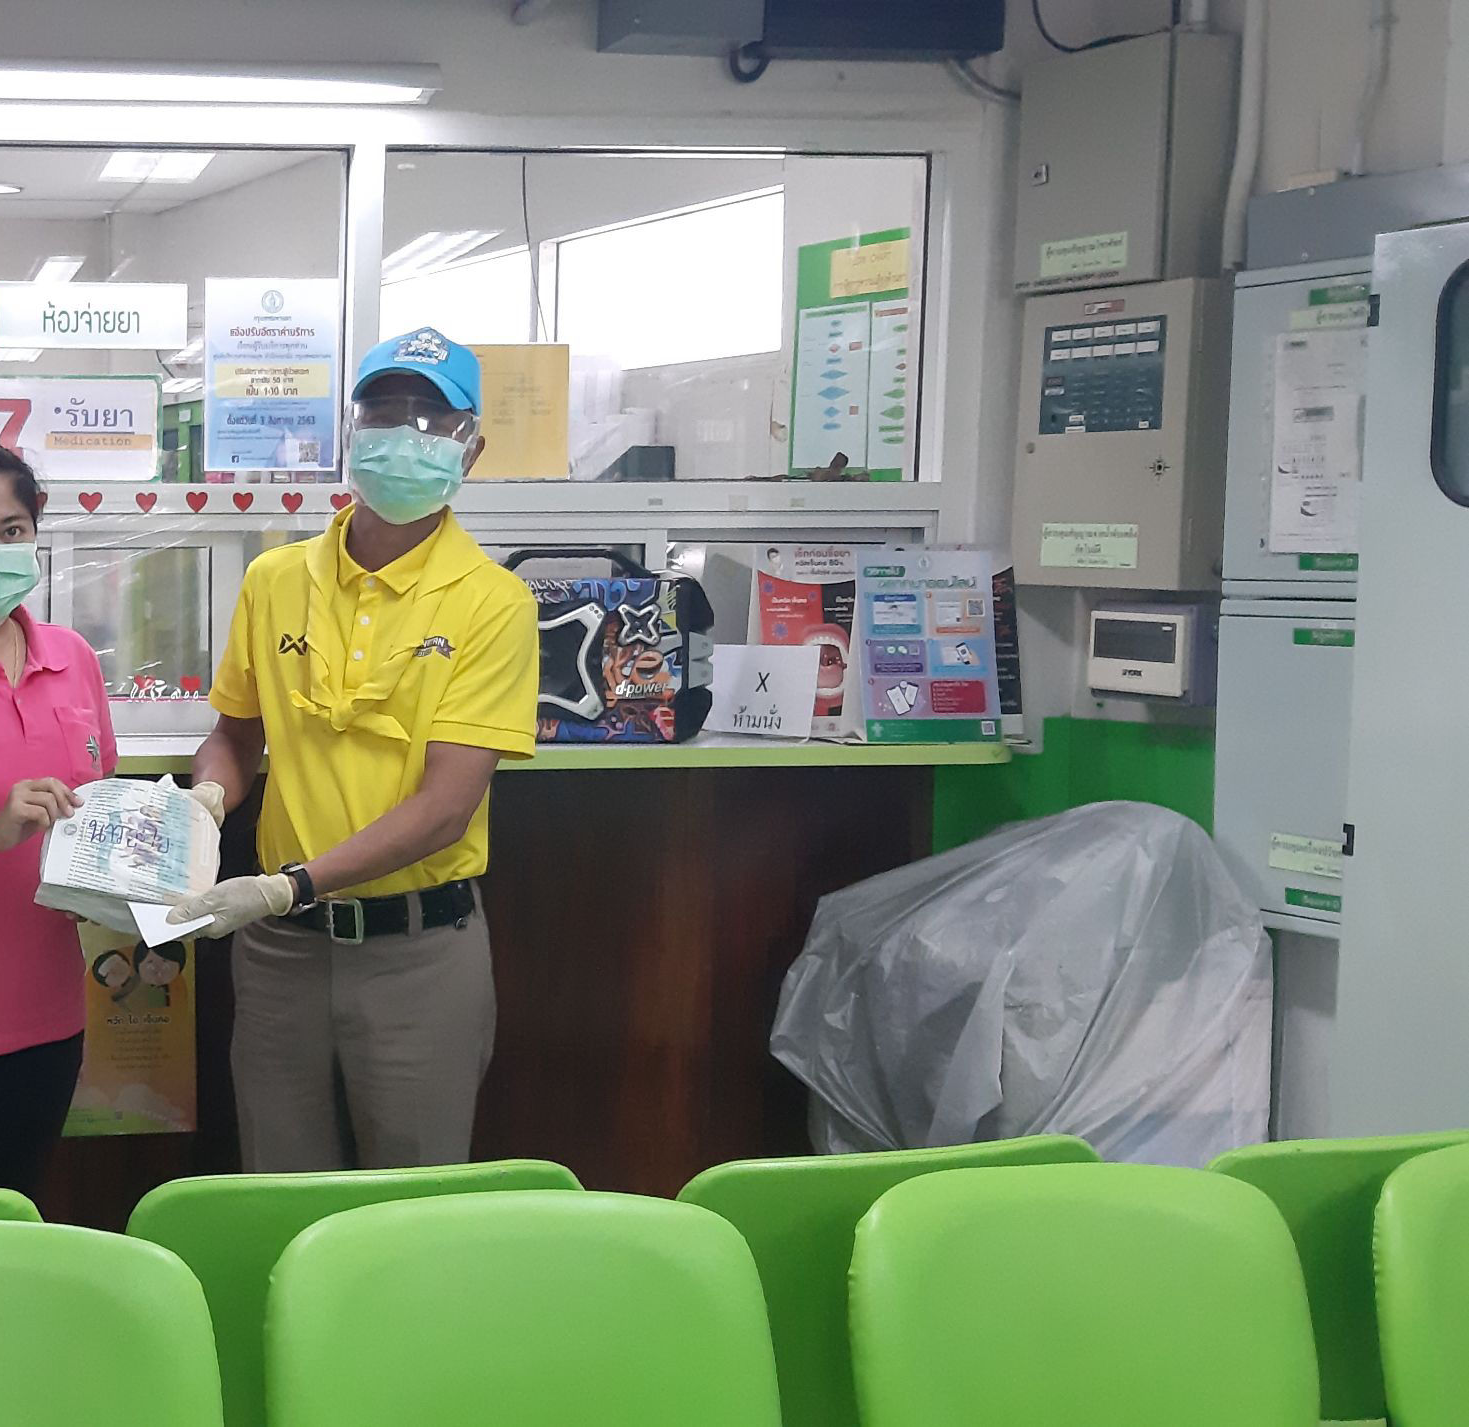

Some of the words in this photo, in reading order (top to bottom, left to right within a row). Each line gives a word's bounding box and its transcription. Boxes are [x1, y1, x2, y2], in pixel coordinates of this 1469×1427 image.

[43, 301, 140, 334] ห้องจ่ายยา
[230, 326, 315, 337] แจ้งปรับอัตราค่าบริการ
[65, 397, 134, 428] รับยา
[54, 435, 132, 447] Medication
[733, 704, 782, 730] ห้ามนั่ง
